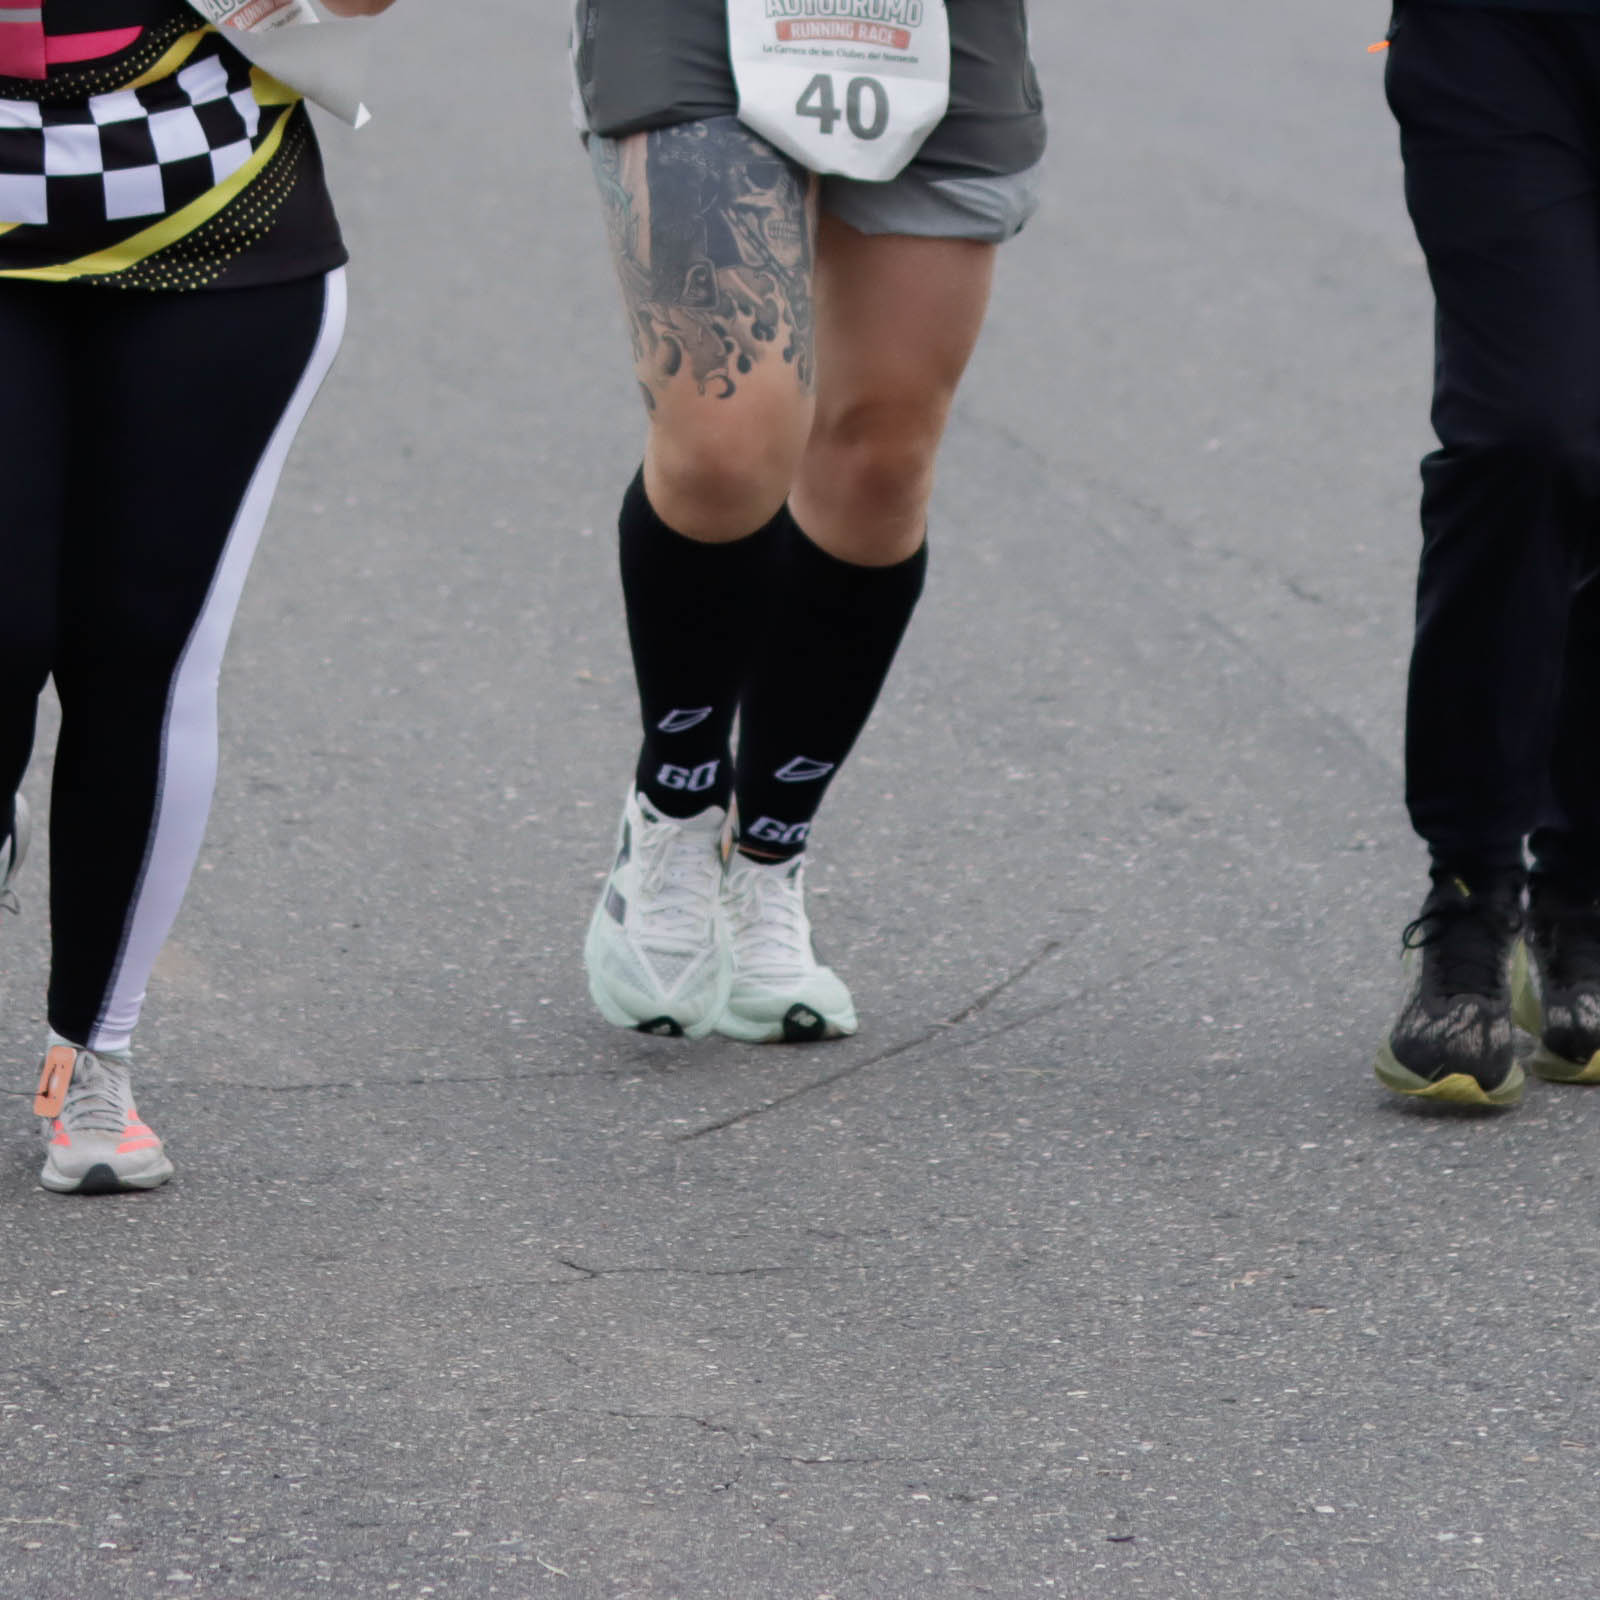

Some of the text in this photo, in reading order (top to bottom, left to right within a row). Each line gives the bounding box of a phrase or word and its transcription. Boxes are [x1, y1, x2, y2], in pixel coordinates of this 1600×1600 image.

[790, 20, 894, 45] RUNNING RACE
[795, 73, 890, 141] 40
[656, 759, 721, 792] GO
